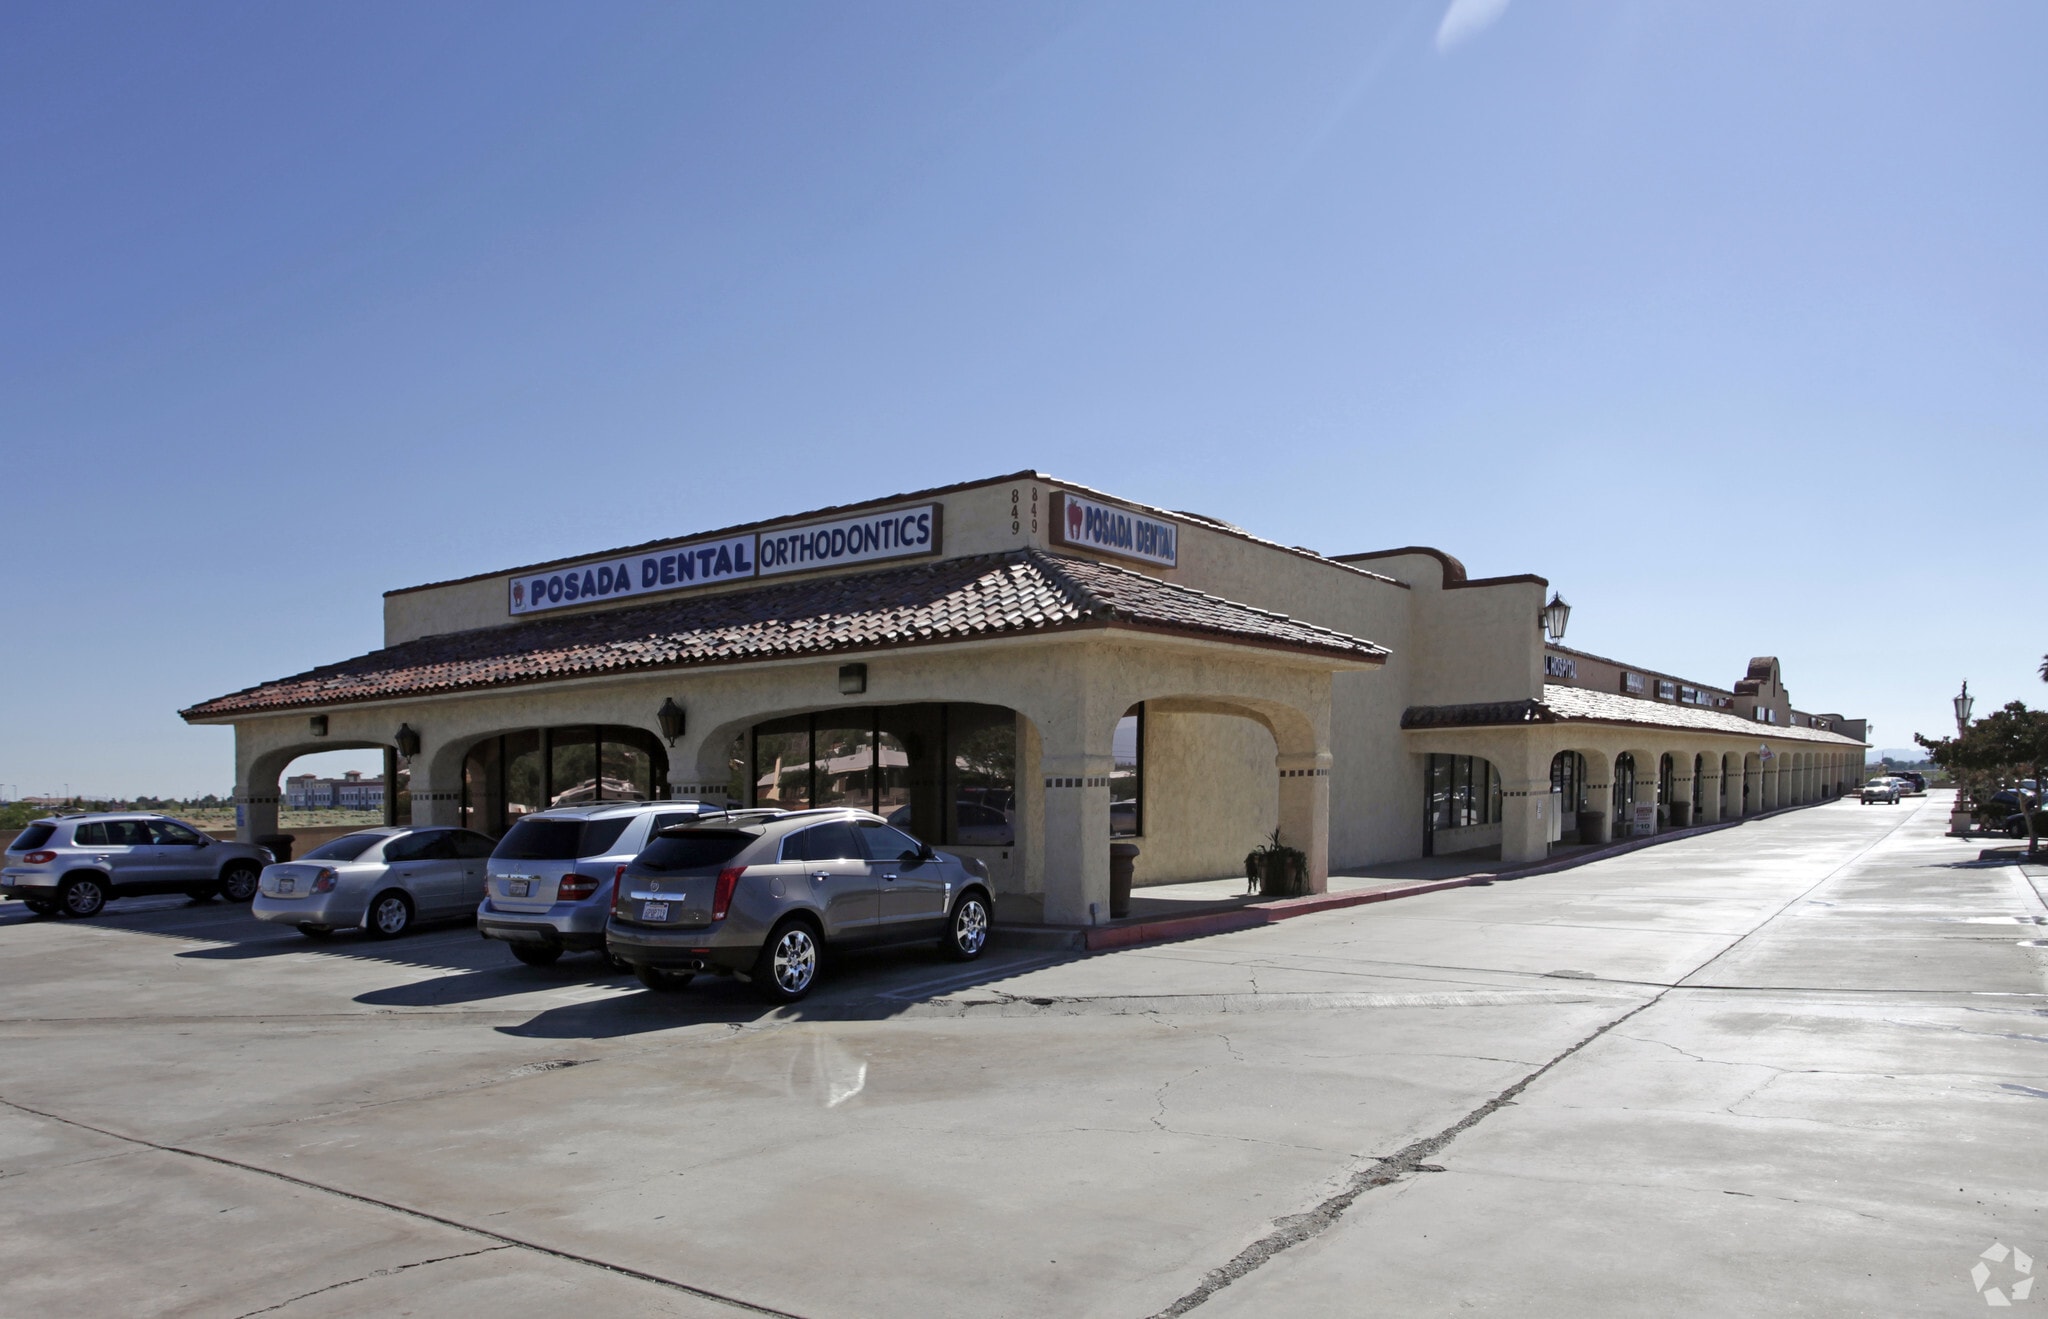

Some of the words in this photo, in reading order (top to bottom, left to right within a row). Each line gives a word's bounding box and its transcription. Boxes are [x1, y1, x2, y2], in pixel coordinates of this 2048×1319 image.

[1011, 488, 1020, 535] 849
[1031, 487, 1039, 534] 849
[1085, 506, 1133, 551] POSADA
[1136, 520, 1175, 561] DENTAL
[760, 513, 930, 568] ORTHODONTICS
[530, 563, 631, 606] POSADA
[641, 542, 752, 589] DENTAL
[1550, 656, 1577, 679] HOSPITAL
